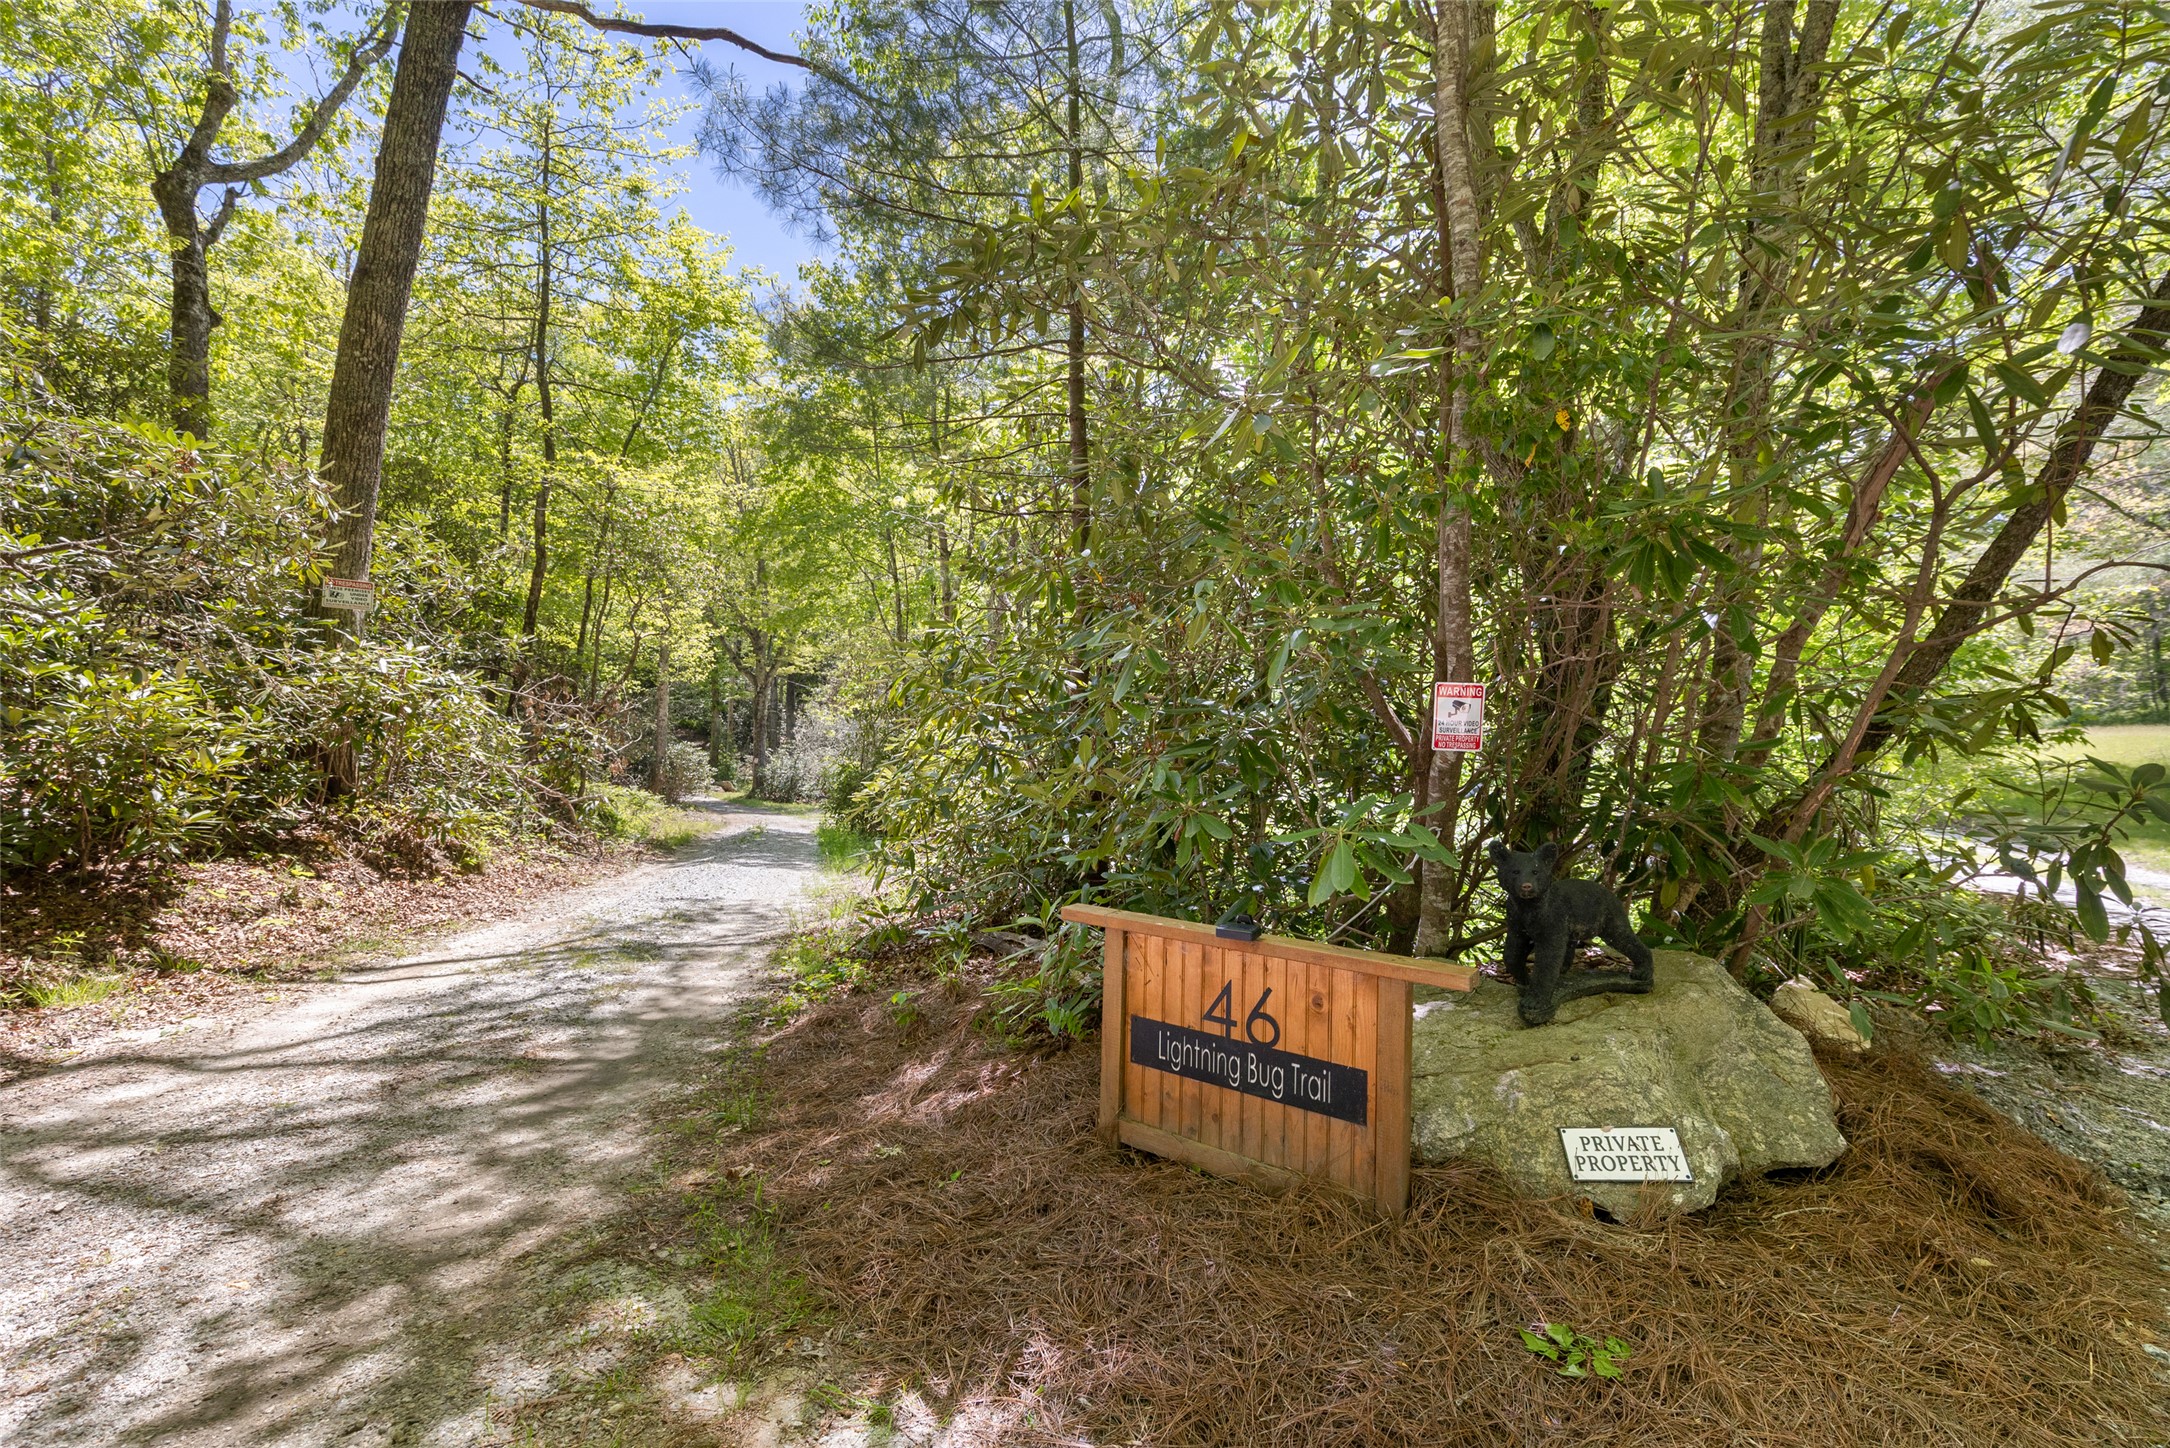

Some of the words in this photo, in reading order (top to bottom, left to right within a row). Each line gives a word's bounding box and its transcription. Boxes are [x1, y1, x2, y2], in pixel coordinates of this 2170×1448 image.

[335, 580, 371, 588] TRESPASSING
[1439, 686, 1482, 697] WARNING
[1203, 979, 1280, 1048] 46
[1158, 1030, 1241, 1087] Lightning
[1247, 1052, 1284, 1099] Bug
[1291, 1063, 1331, 1104] Trail
[1579, 1136, 1665, 1152] PRIVATE
[1576, 1155, 1681, 1172] PROPERTY
